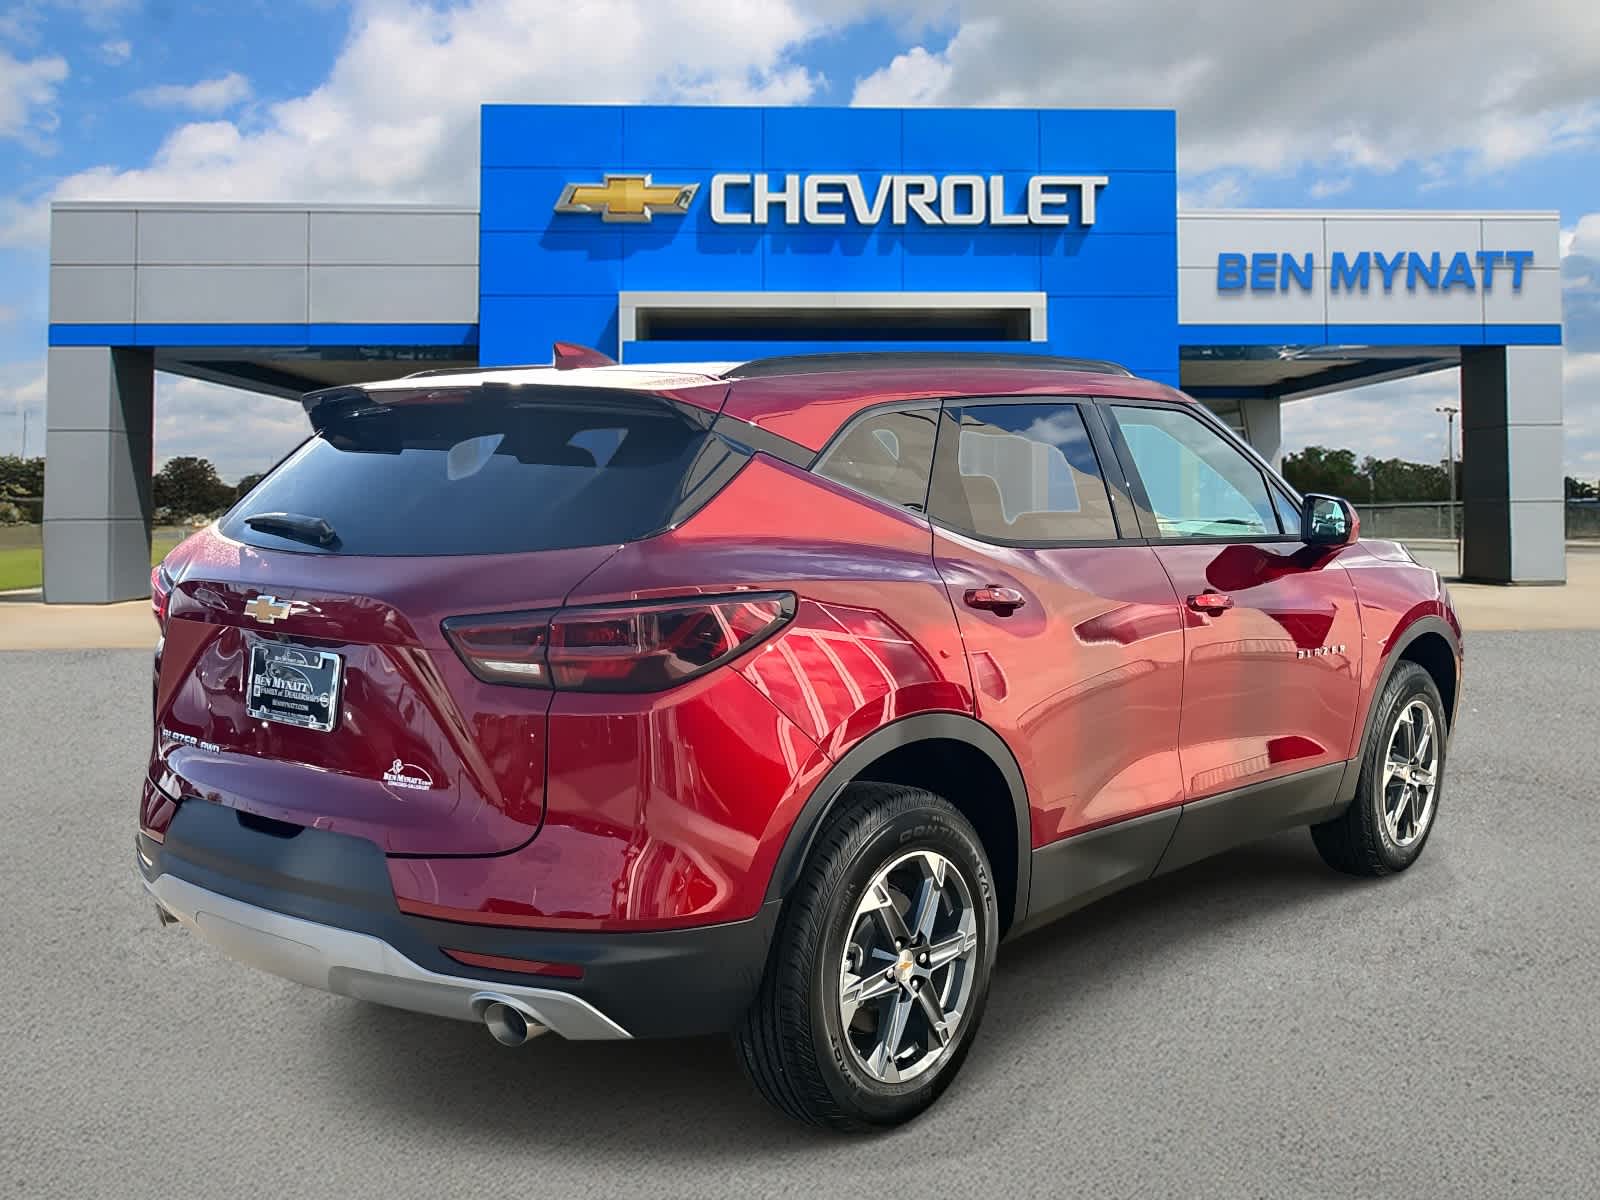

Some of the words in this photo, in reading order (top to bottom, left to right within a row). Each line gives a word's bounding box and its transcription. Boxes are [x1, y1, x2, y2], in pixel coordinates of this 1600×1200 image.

[710, 173, 1110, 226] CHEVROLET
[1216, 252, 1314, 291] BEN
[1329, 250, 1535, 291] MYNATT
[254, 674, 272, 687] BEN
[272, 676, 309, 693] MYNATT
